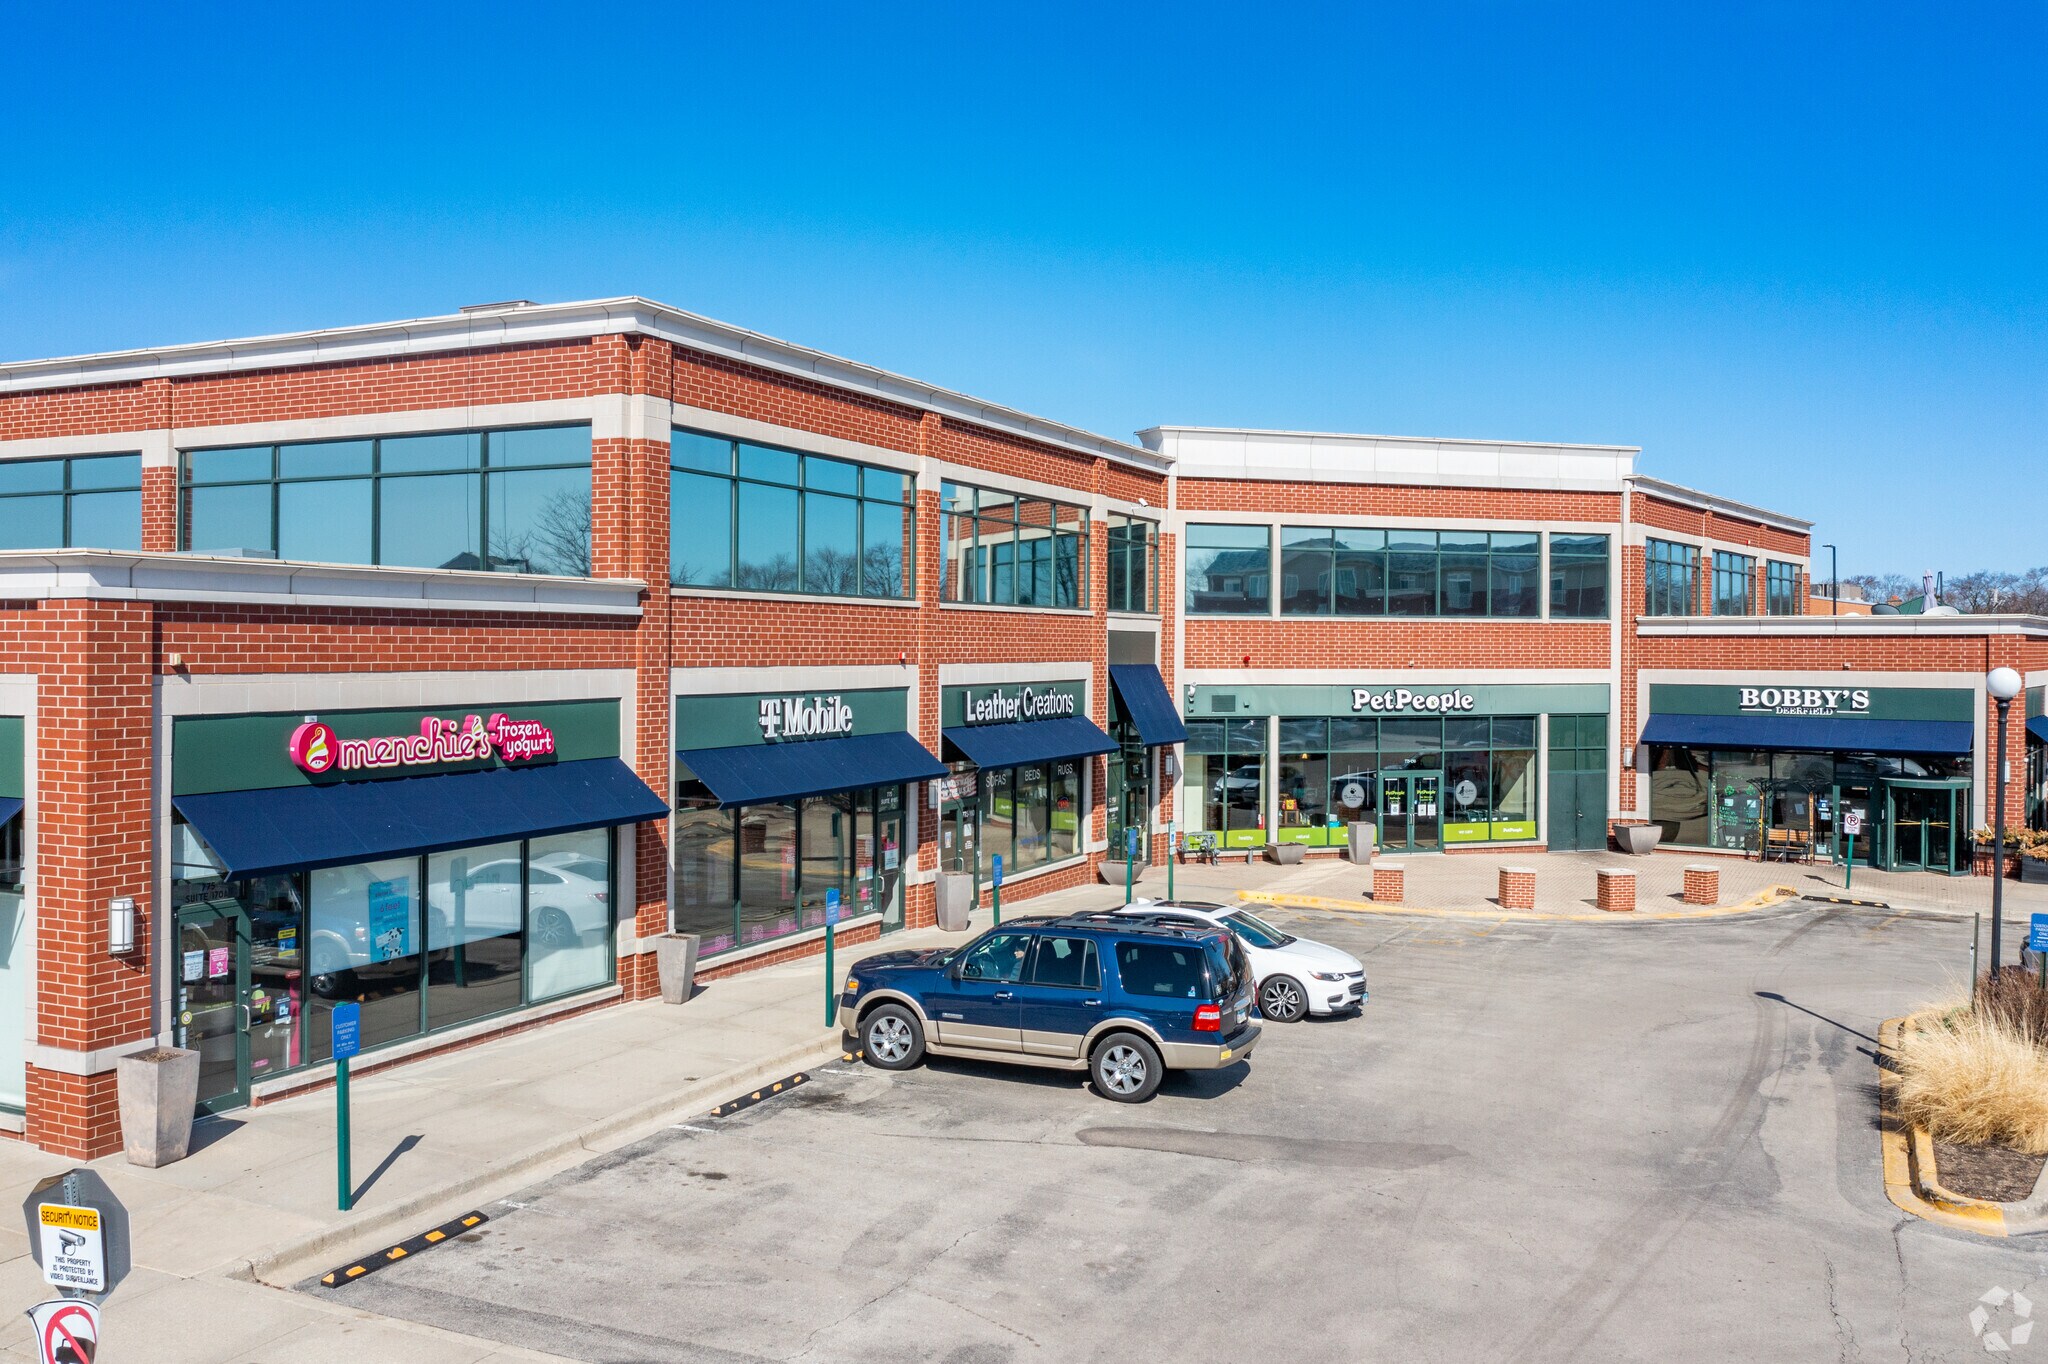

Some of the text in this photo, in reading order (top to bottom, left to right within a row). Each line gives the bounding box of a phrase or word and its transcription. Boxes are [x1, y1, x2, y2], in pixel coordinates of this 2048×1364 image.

[966, 687, 1074, 721] Leather Creations
[1740, 688, 1870, 709] BOBBY'S
[1775, 706, 1834, 716] DEERFIELD
[497, 717, 542, 744] frozen
[341, 715, 491, 770] menchie's
[506, 735, 552, 758] yogurt
[1025, 769, 1041, 781] BEDS
[1057, 763, 1073, 776] RUGS
[985, 773, 1007, 788] SOFAS
[185, 892, 208, 904] SUITE
[335, 1021, 356, 1029] CUSTOMER
[337, 1027, 354, 1035] PARKING
[41, 1210, 98, 1227] SECURITY NOTICE
[67, 1258, 91, 1267] PROPERTY
[59, 1265, 86, 1275] PROTECTED
[87, 1268, 94, 1276] BY
[50, 1272, 99, 1285] VIDEO SURVEILLANCE
